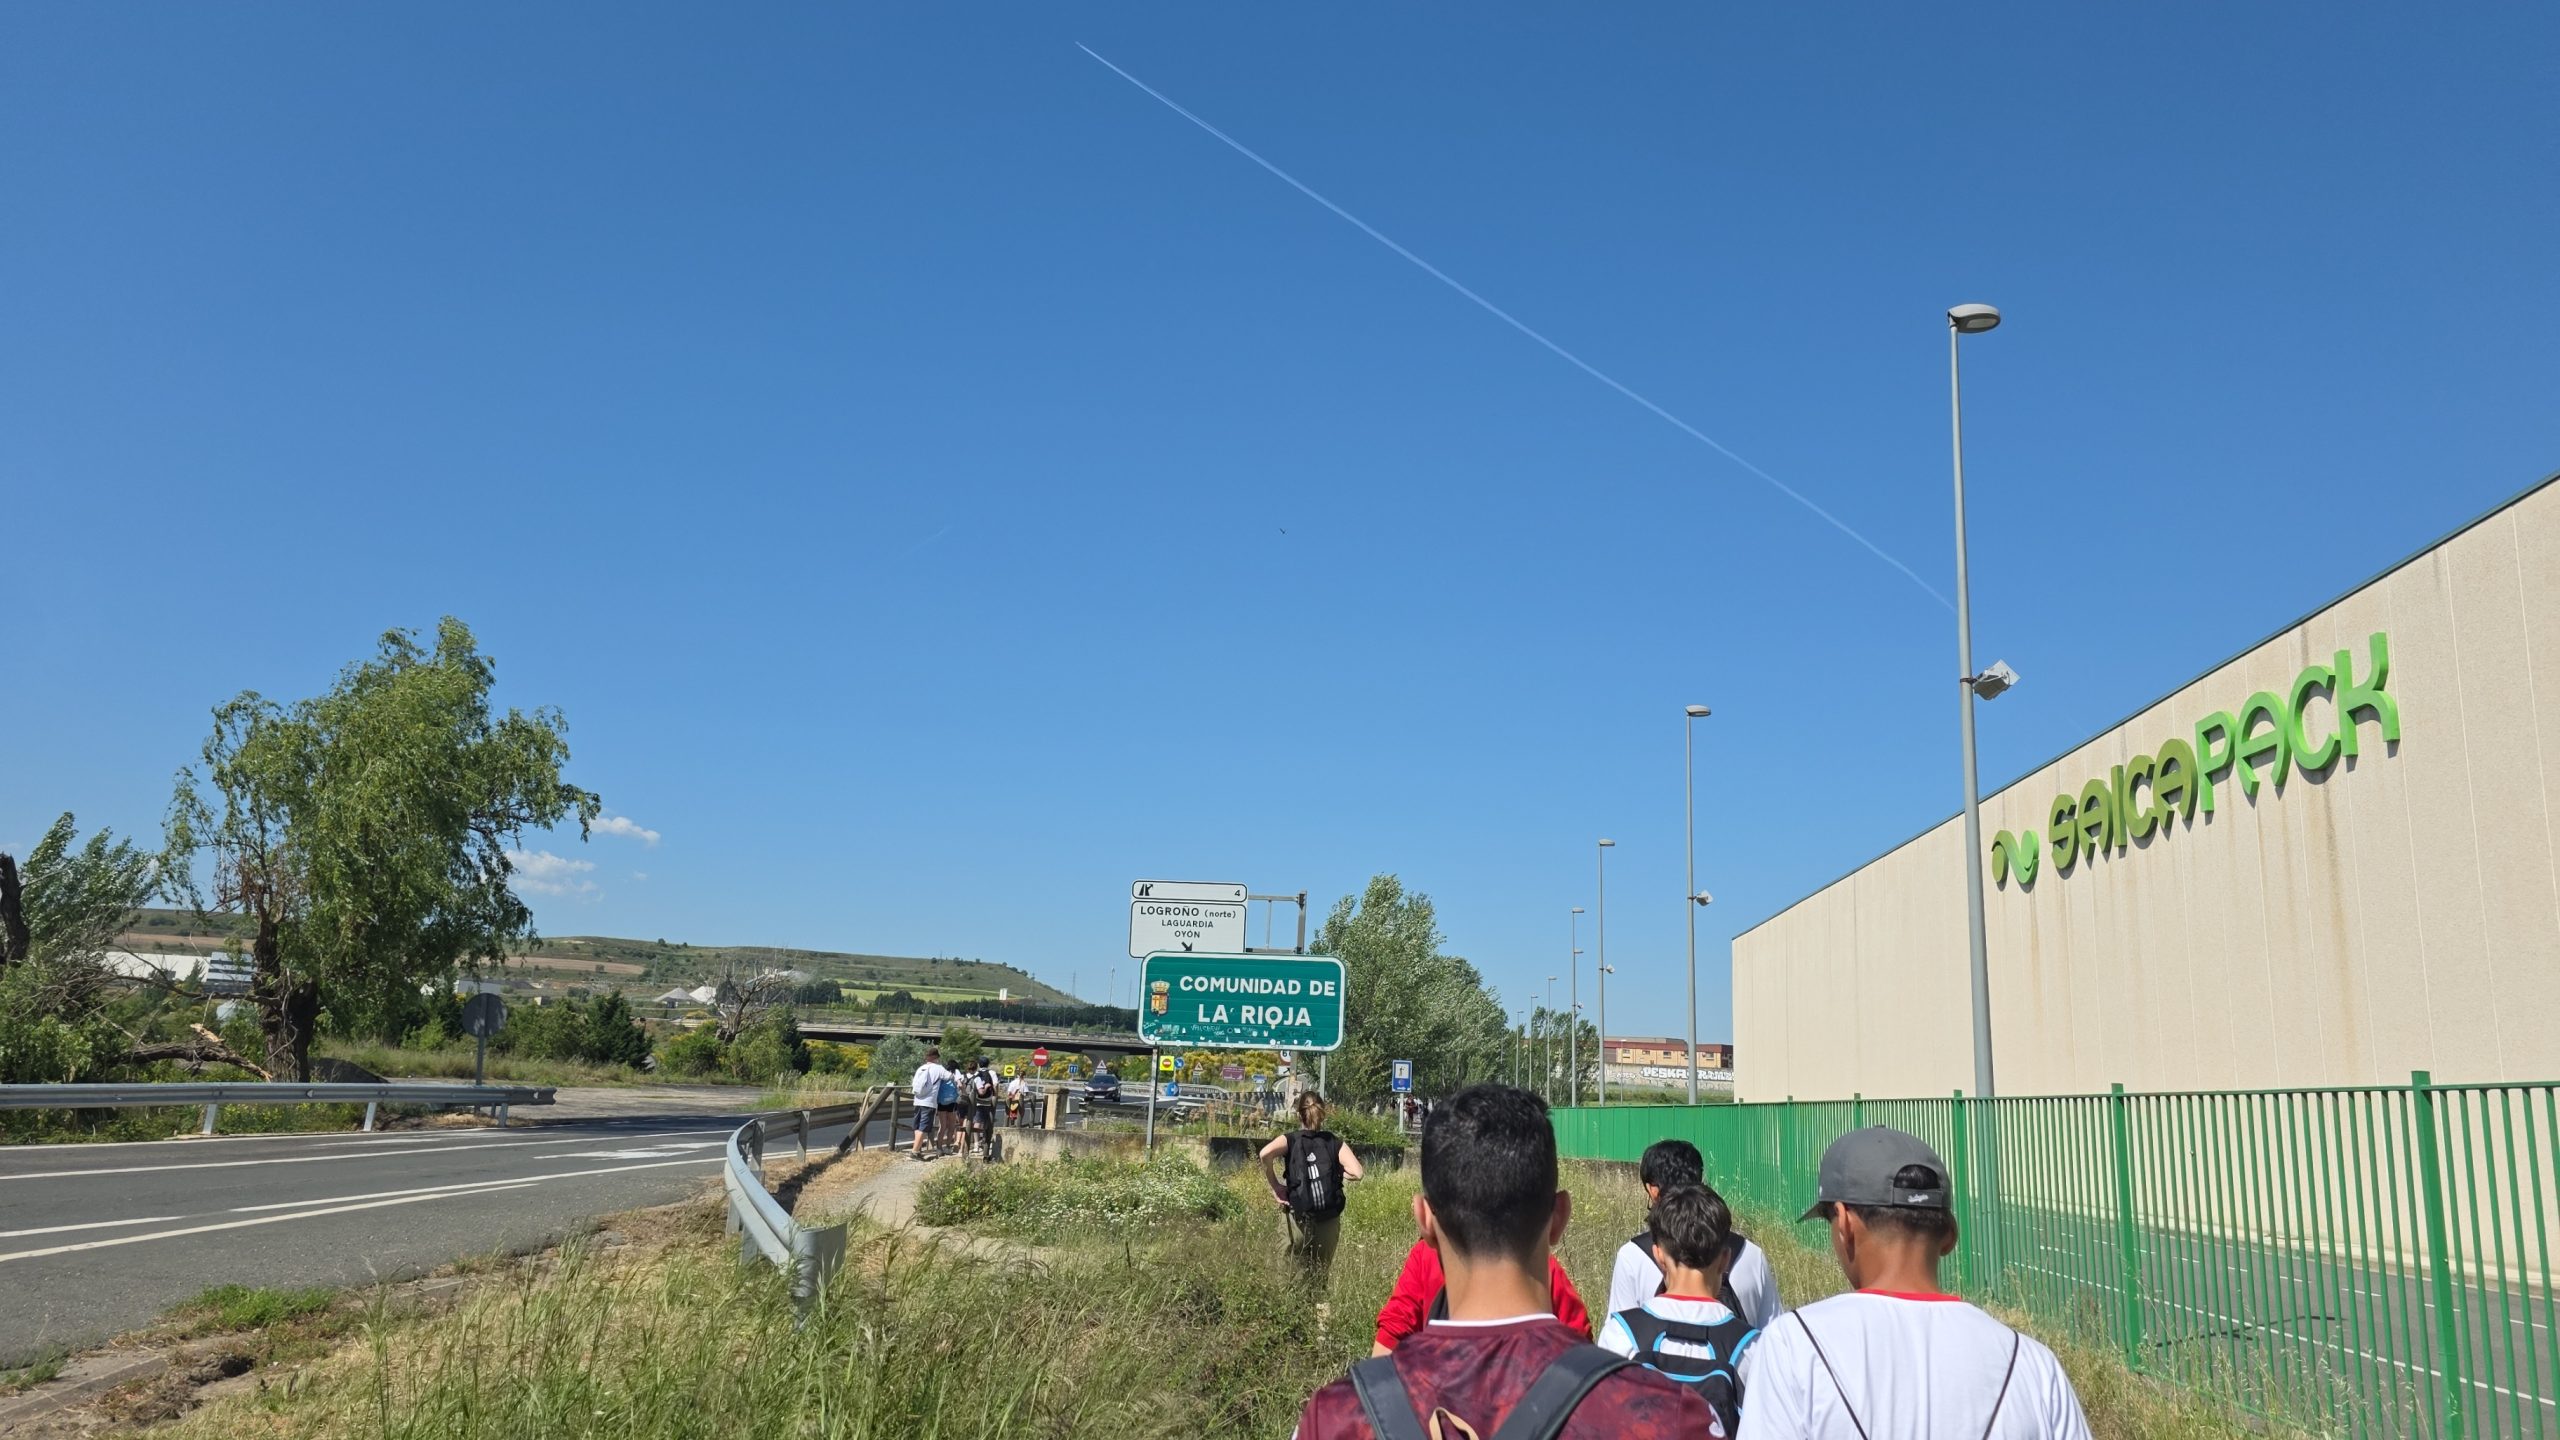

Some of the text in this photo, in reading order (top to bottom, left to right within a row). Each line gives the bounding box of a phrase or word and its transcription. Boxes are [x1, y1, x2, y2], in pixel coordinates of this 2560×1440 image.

[1234, 889, 1241, 897] 4
[1140, 905, 1236, 919] LOGROÑO (norte)
[1161, 919, 1214, 928] LAGUARDIA
[1174, 929, 1201, 938] OYÓN
[1179, 975, 1336, 997] COMUNIDAD DE
[1198, 1003, 1312, 1027] LA RIOJA
